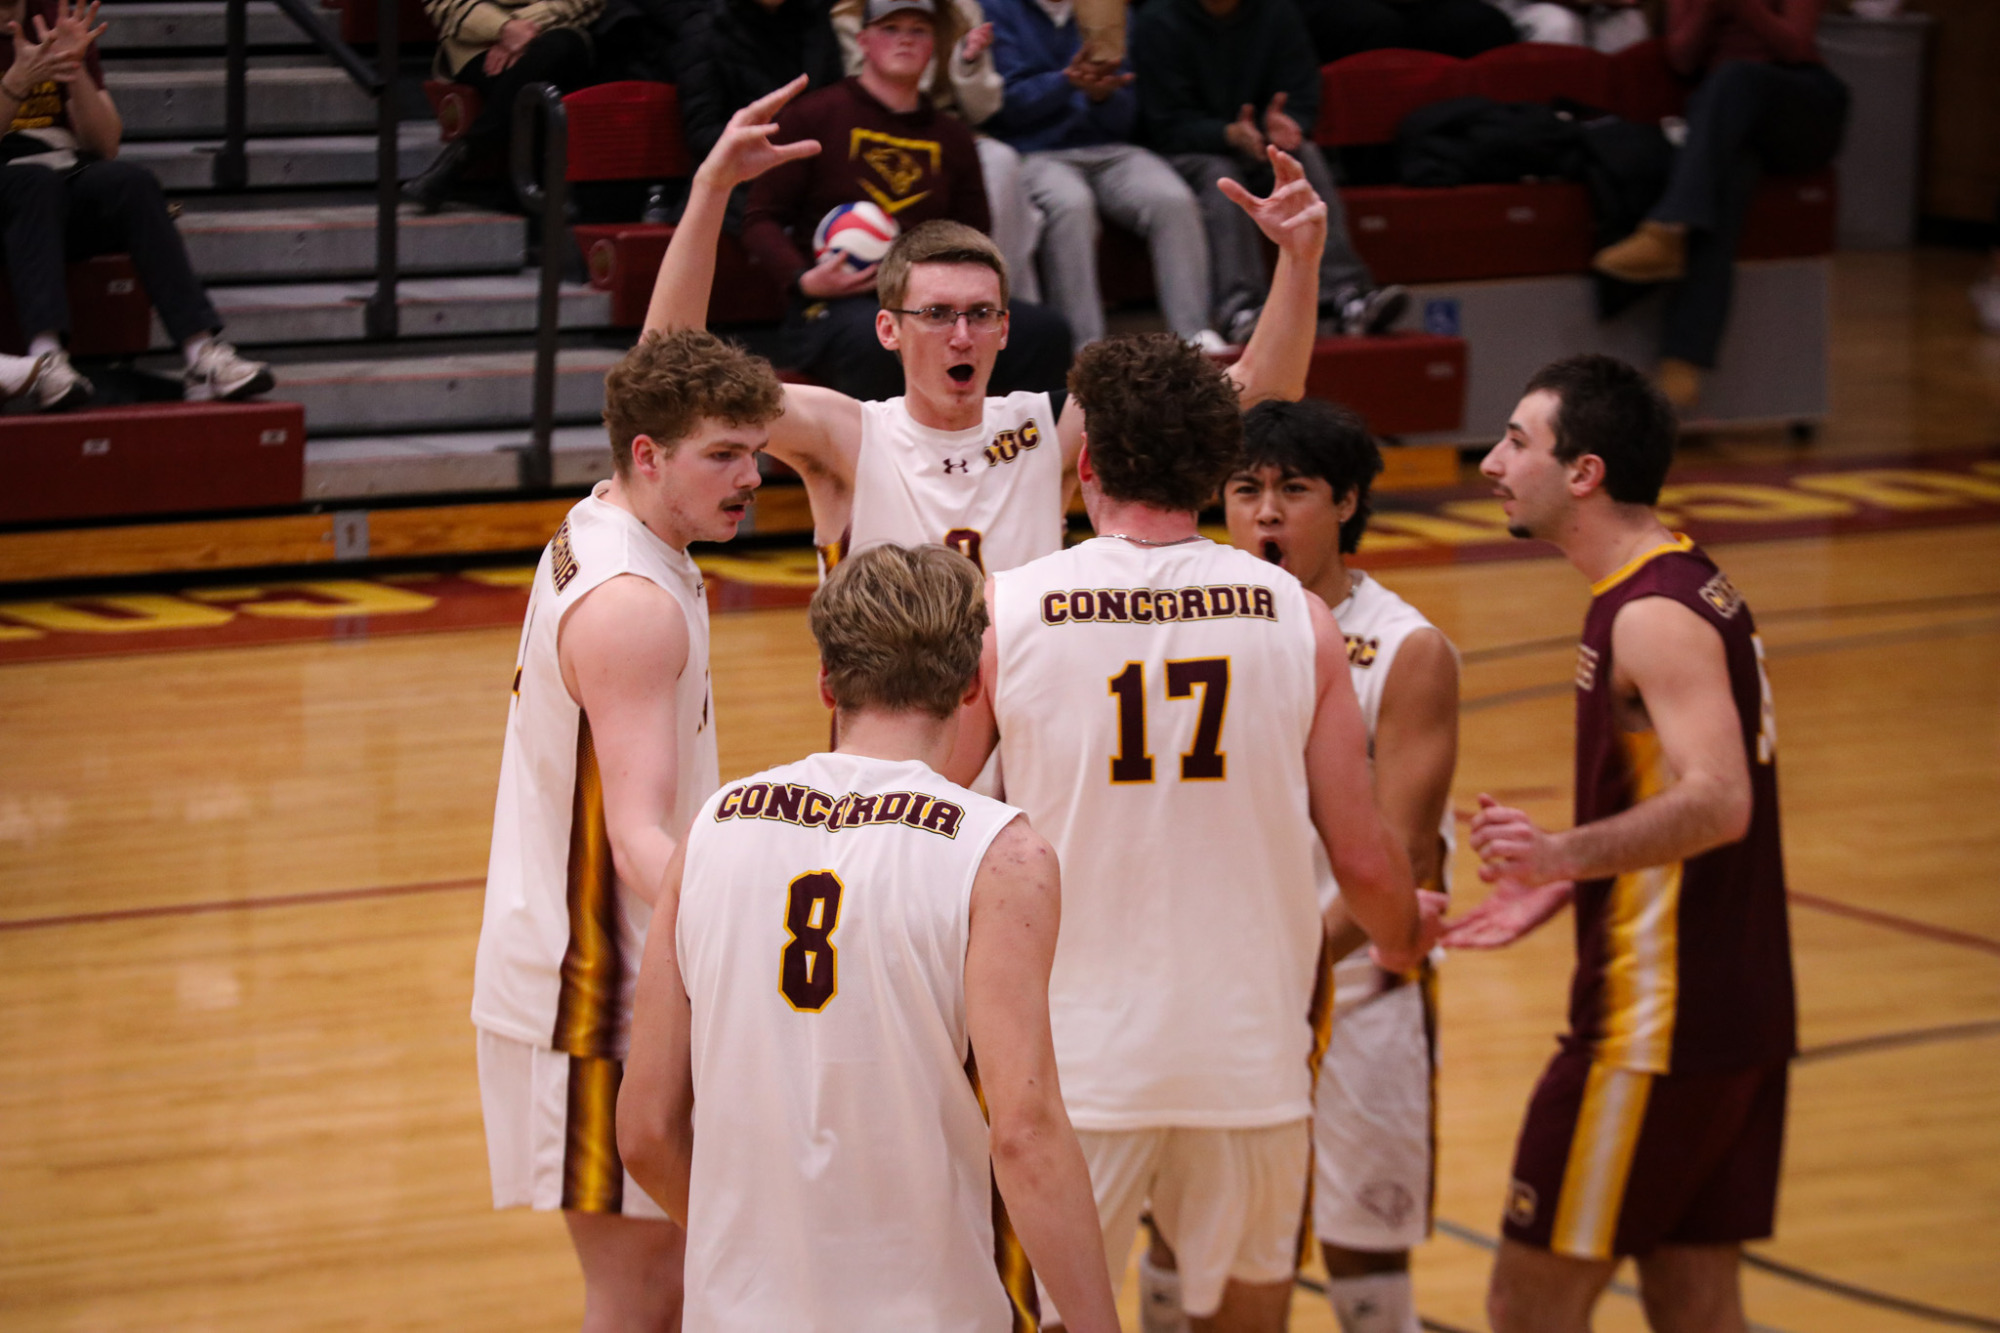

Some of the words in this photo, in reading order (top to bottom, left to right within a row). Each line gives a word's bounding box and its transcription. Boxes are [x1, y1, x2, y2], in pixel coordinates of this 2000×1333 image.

[1041, 584, 1278, 626] CONCORDIA
[1107, 655, 1231, 785] 17
[714, 782, 965, 840] CONCORDIA
[777, 868, 845, 1014] 8
